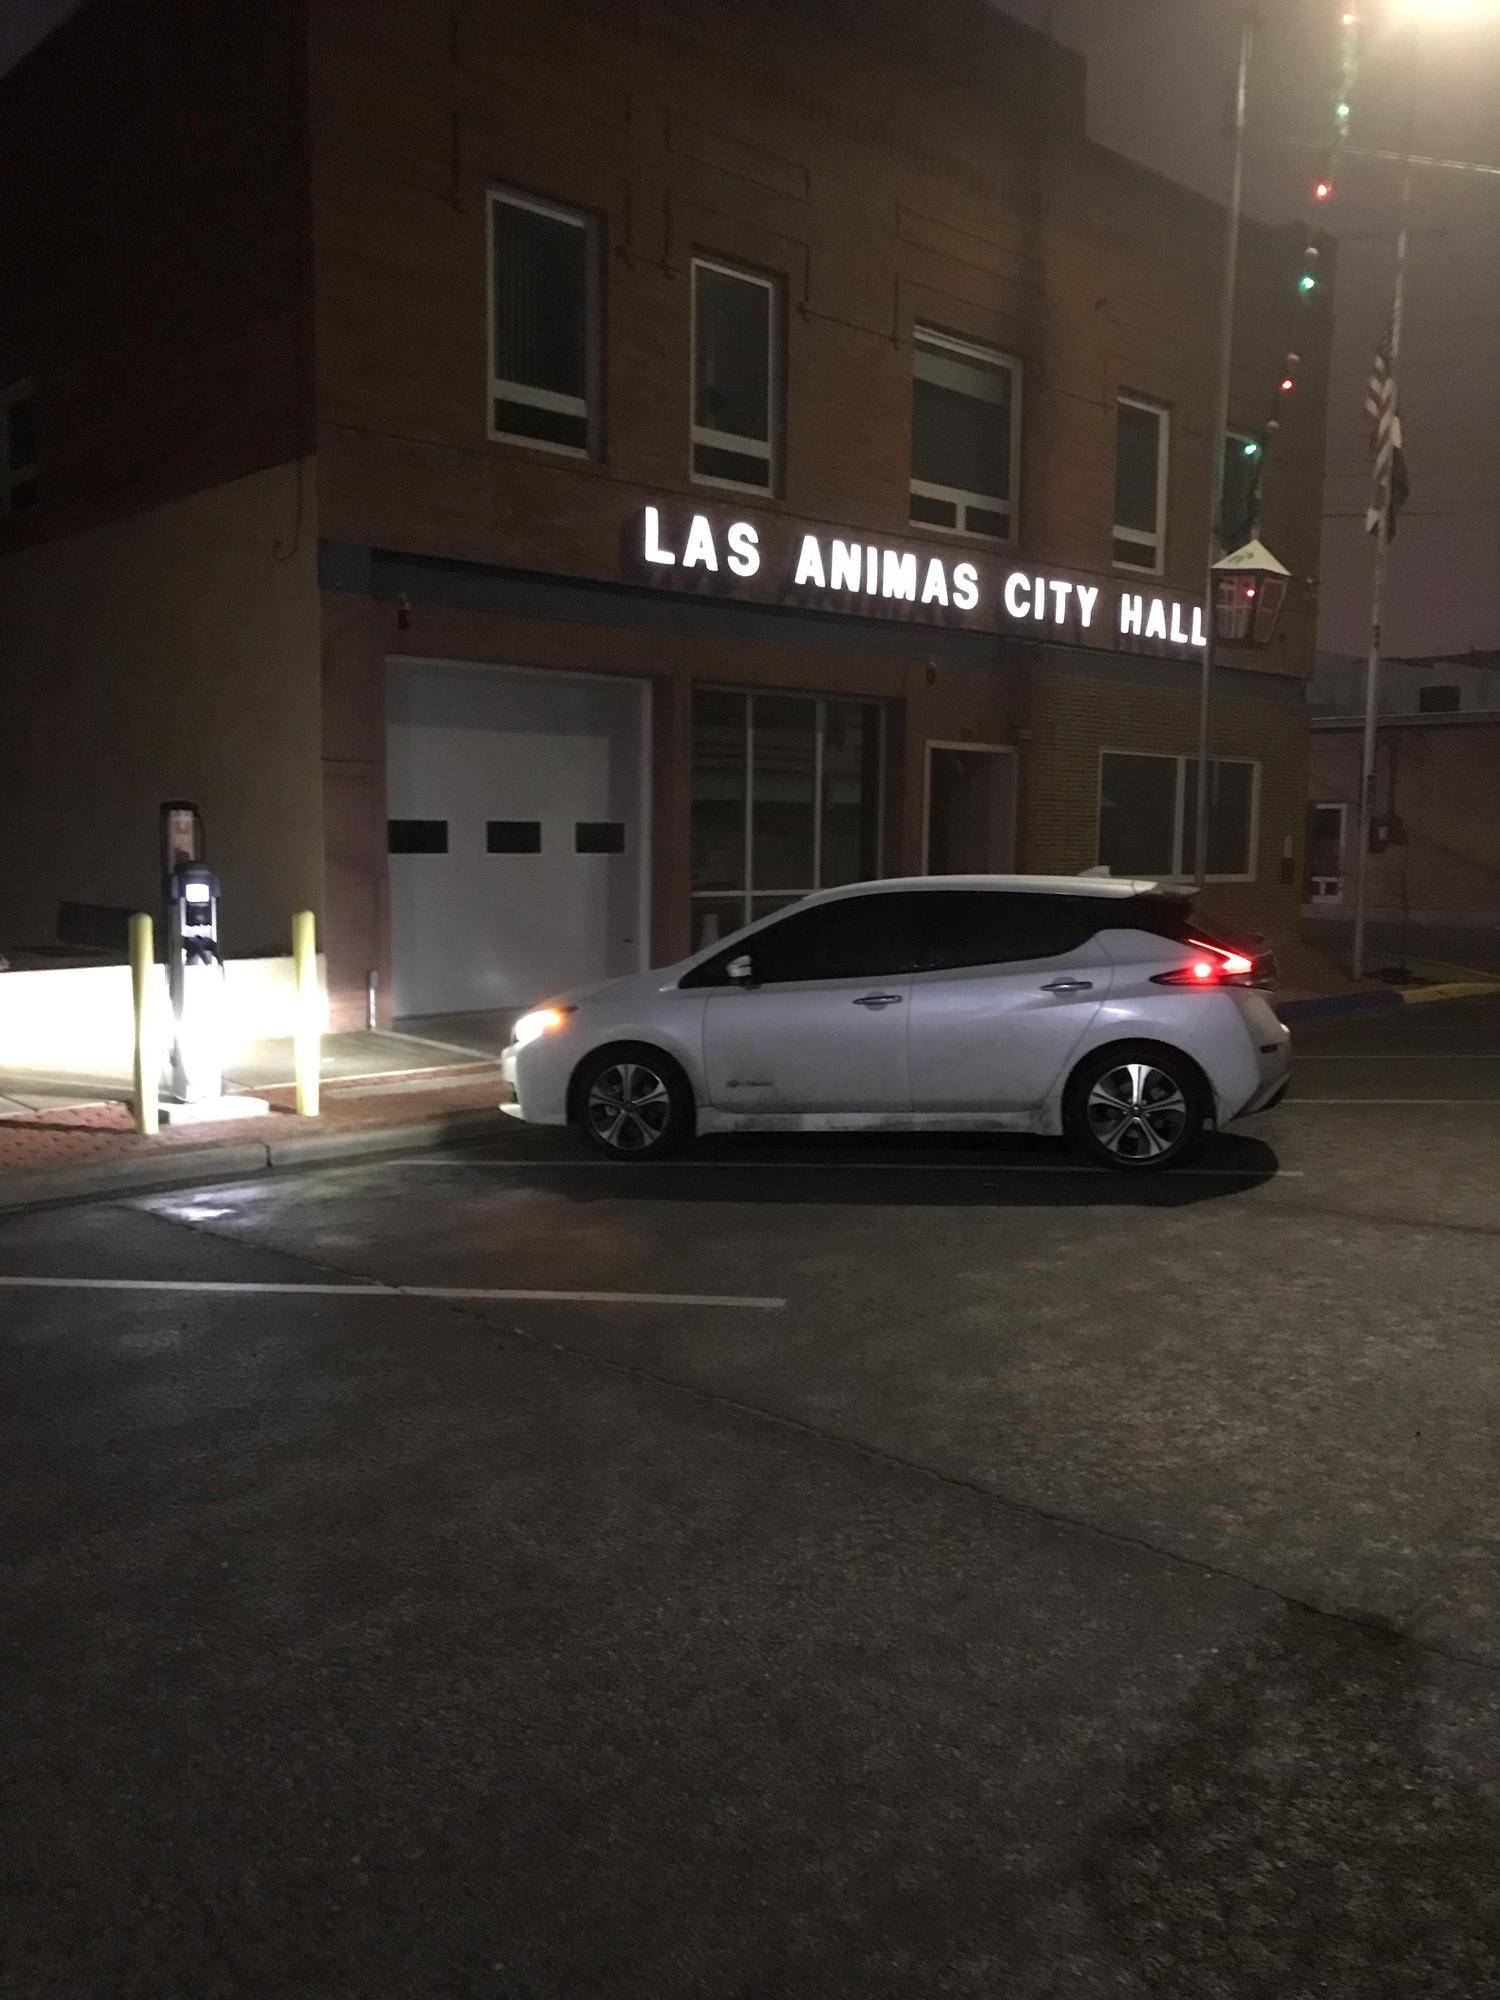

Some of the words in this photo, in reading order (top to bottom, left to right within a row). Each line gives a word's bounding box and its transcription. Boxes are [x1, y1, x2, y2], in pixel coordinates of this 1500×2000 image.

[644, 505, 761, 577] LAS
[794, 534, 979, 611] ANIMAS
[1004, 571, 1099, 628] CITY
[1120, 592, 1207, 648] HALL
